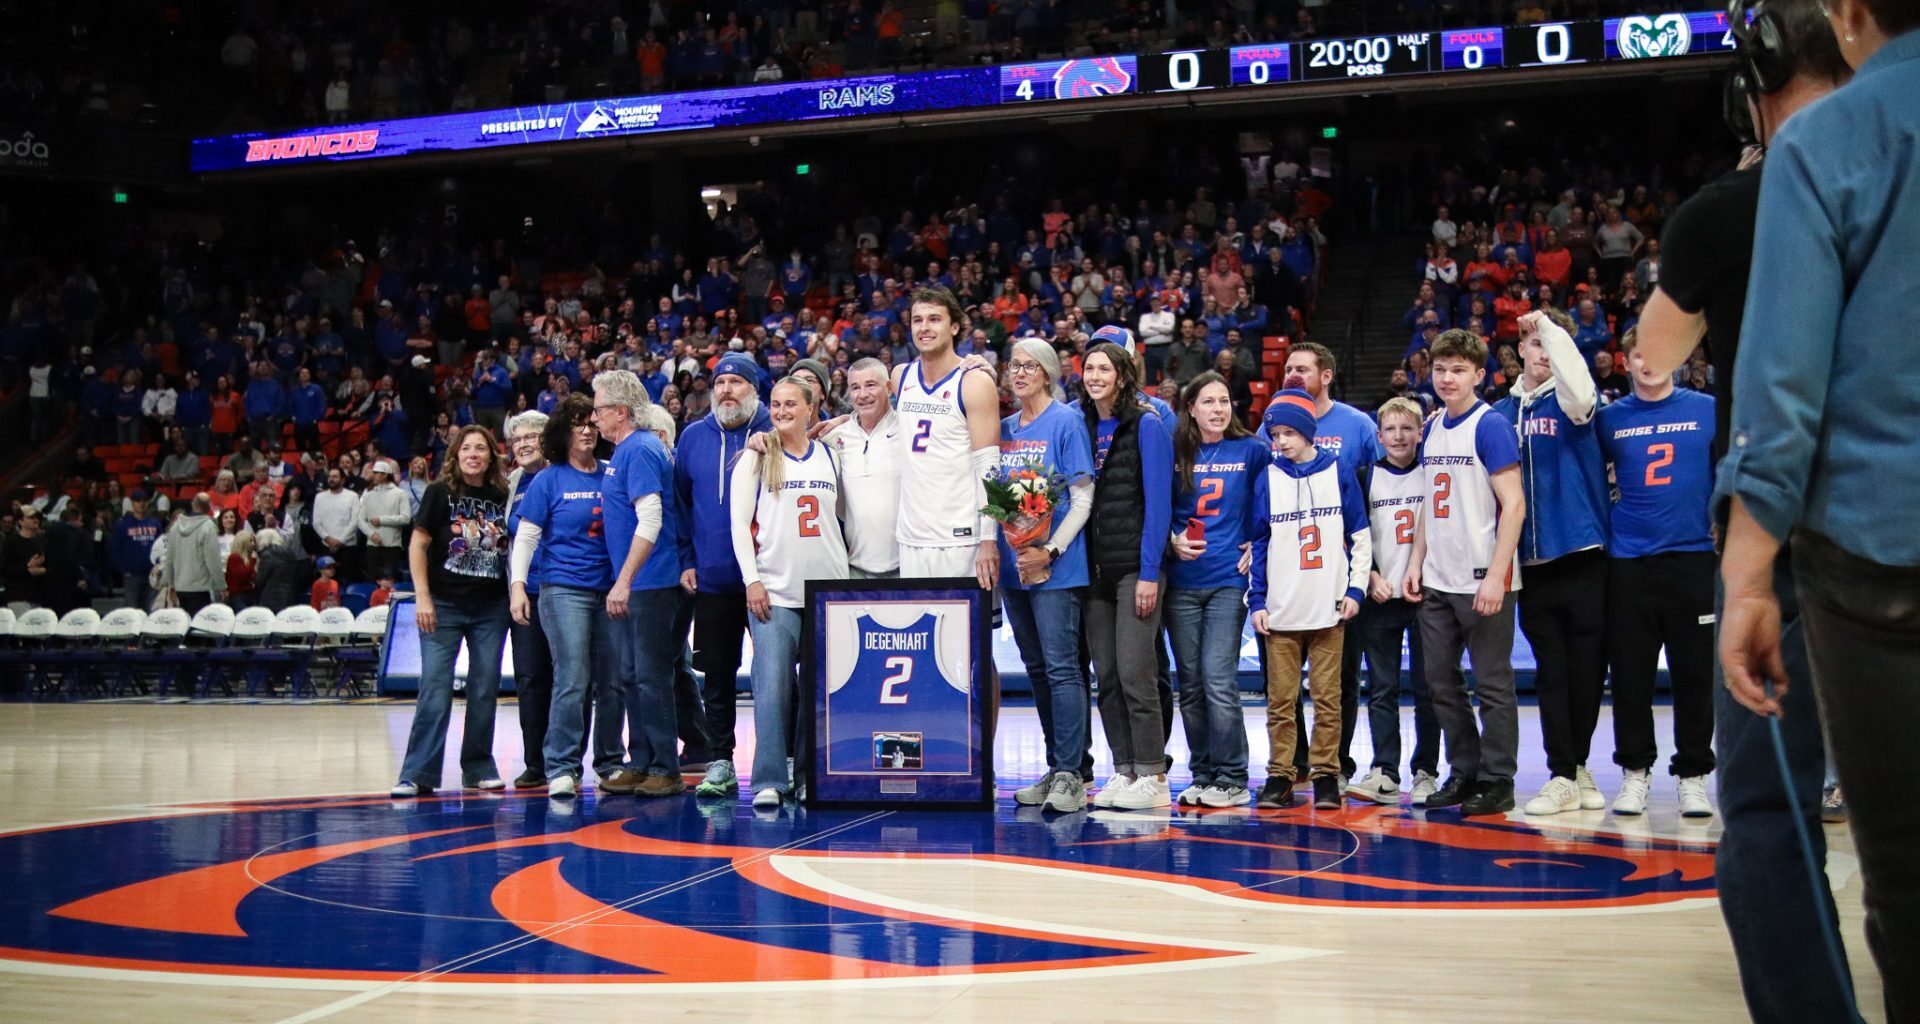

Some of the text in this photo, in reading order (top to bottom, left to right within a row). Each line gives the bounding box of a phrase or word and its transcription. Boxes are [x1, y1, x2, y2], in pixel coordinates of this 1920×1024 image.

[1398, 33, 1430, 46] HALF
[1449, 31, 1495, 45] FOULS
[1537, 24, 1569, 65] 0
[1721, 28, 1737, 50] 4
[1237, 47, 1281, 61] FOULS
[1309, 37, 1391, 67] 20:00
[1408, 46, 1417, 62] 1
[1463, 46, 1482, 69] 0
[1169, 52, 1200, 91] 0
[1249, 61, 1268, 84] 0
[1347, 64, 1383, 77] POSS
[818, 84, 895, 110] RAMS
[1016, 80, 1034, 100] 4
[615, 104, 662, 117] MOUNTAIN
[618, 114, 659, 125] AMERICA
[481, 117, 563, 135] PRESENTED BY
[245, 129, 379, 162] BRONCOS
[902, 402, 952, 415] BRONCOS
[912, 419, 932, 453] 2
[1614, 422, 1698, 440] BOISE STATE
[1211, 462, 1246, 472] STATE
[1445, 456, 1474, 466] STATE
[1645, 443, 1674, 486] 2
[563, 492, 594, 500] BOISE
[809, 480, 837, 493] STATE
[1433, 472, 1451, 519] 2
[1196, 478, 1224, 516] 2
[1373, 496, 1425, 509] BOISE STA
[797, 495, 821, 537] 2
[1394, 509, 1414, 545] 2
[1299, 525, 1323, 570] 2
[865, 631, 929, 650] DEGENHART
[879, 655, 914, 704] 2
